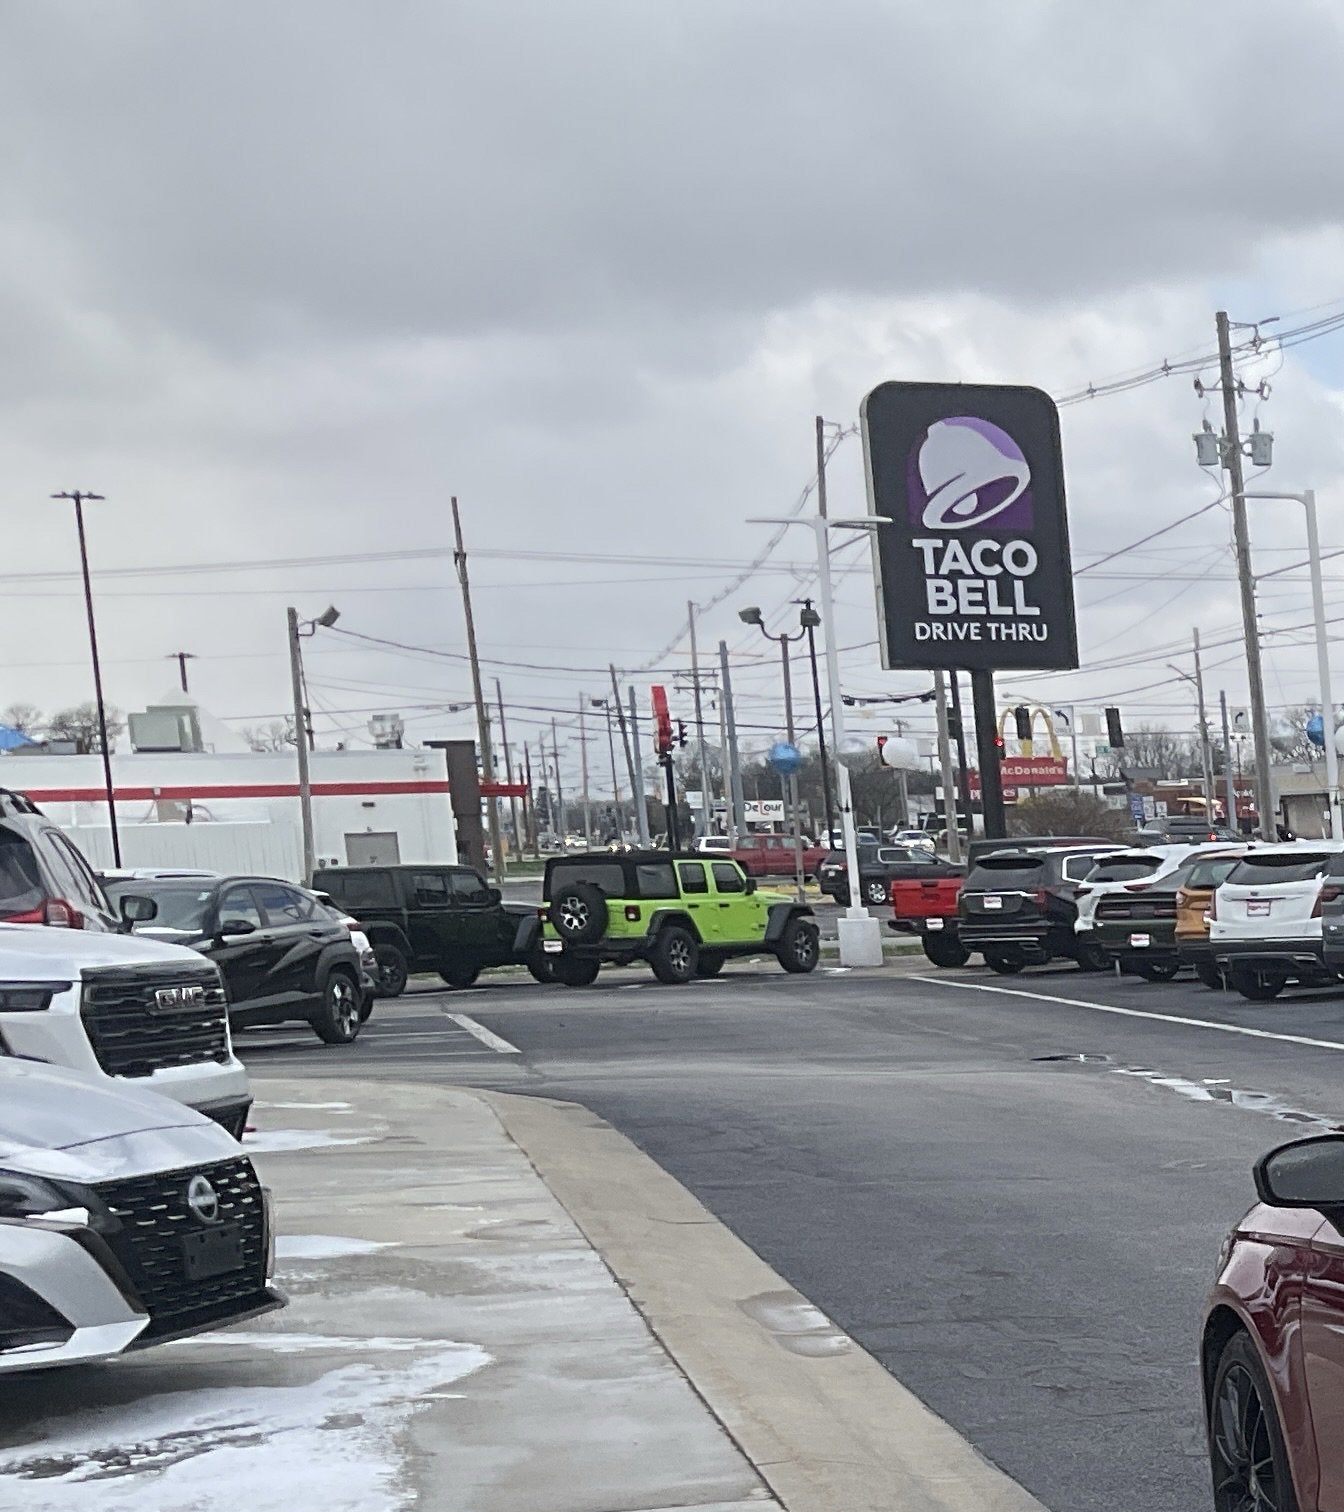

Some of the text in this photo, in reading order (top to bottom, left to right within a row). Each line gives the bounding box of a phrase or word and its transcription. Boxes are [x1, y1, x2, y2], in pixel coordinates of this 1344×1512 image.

[912, 538, 1038, 577] TACO
[926, 578, 1041, 616] BELL
[914, 622, 1048, 642] DRIVE THRU
